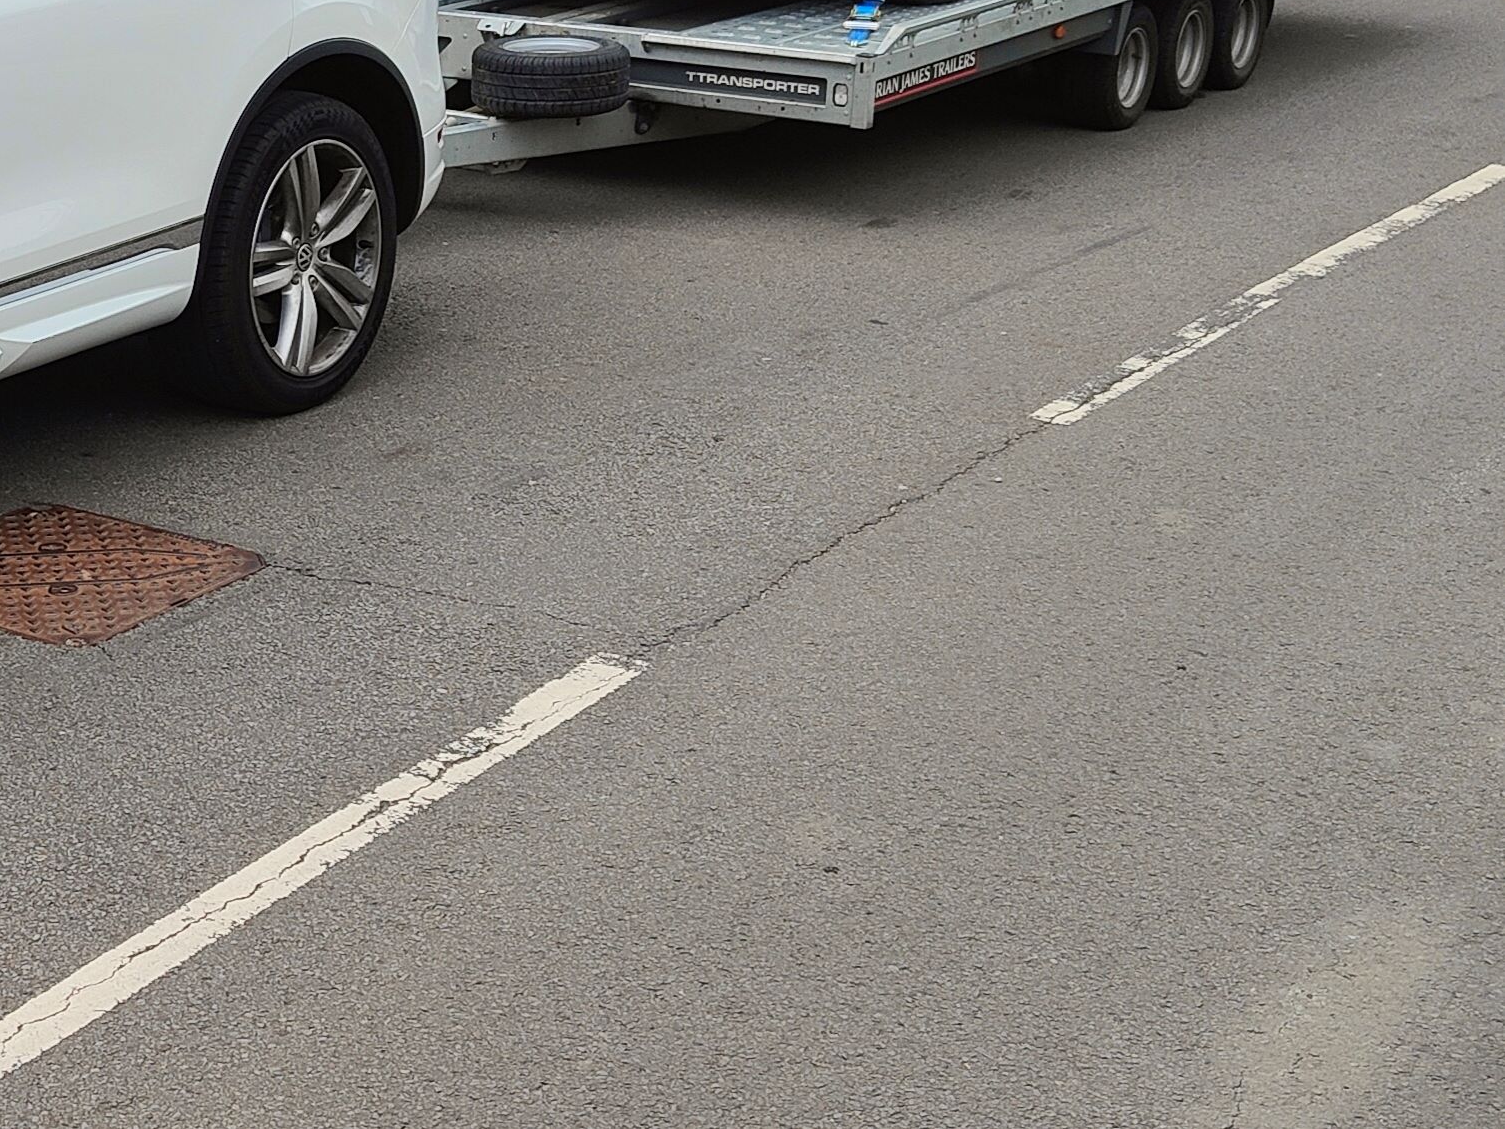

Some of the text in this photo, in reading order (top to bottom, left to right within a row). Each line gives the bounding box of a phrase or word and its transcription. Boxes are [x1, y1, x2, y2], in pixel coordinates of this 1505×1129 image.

[685, 70, 820, 97] TTRANSPORTER
[875, 51, 976, 99] RIAN JAMES TRAILERS
